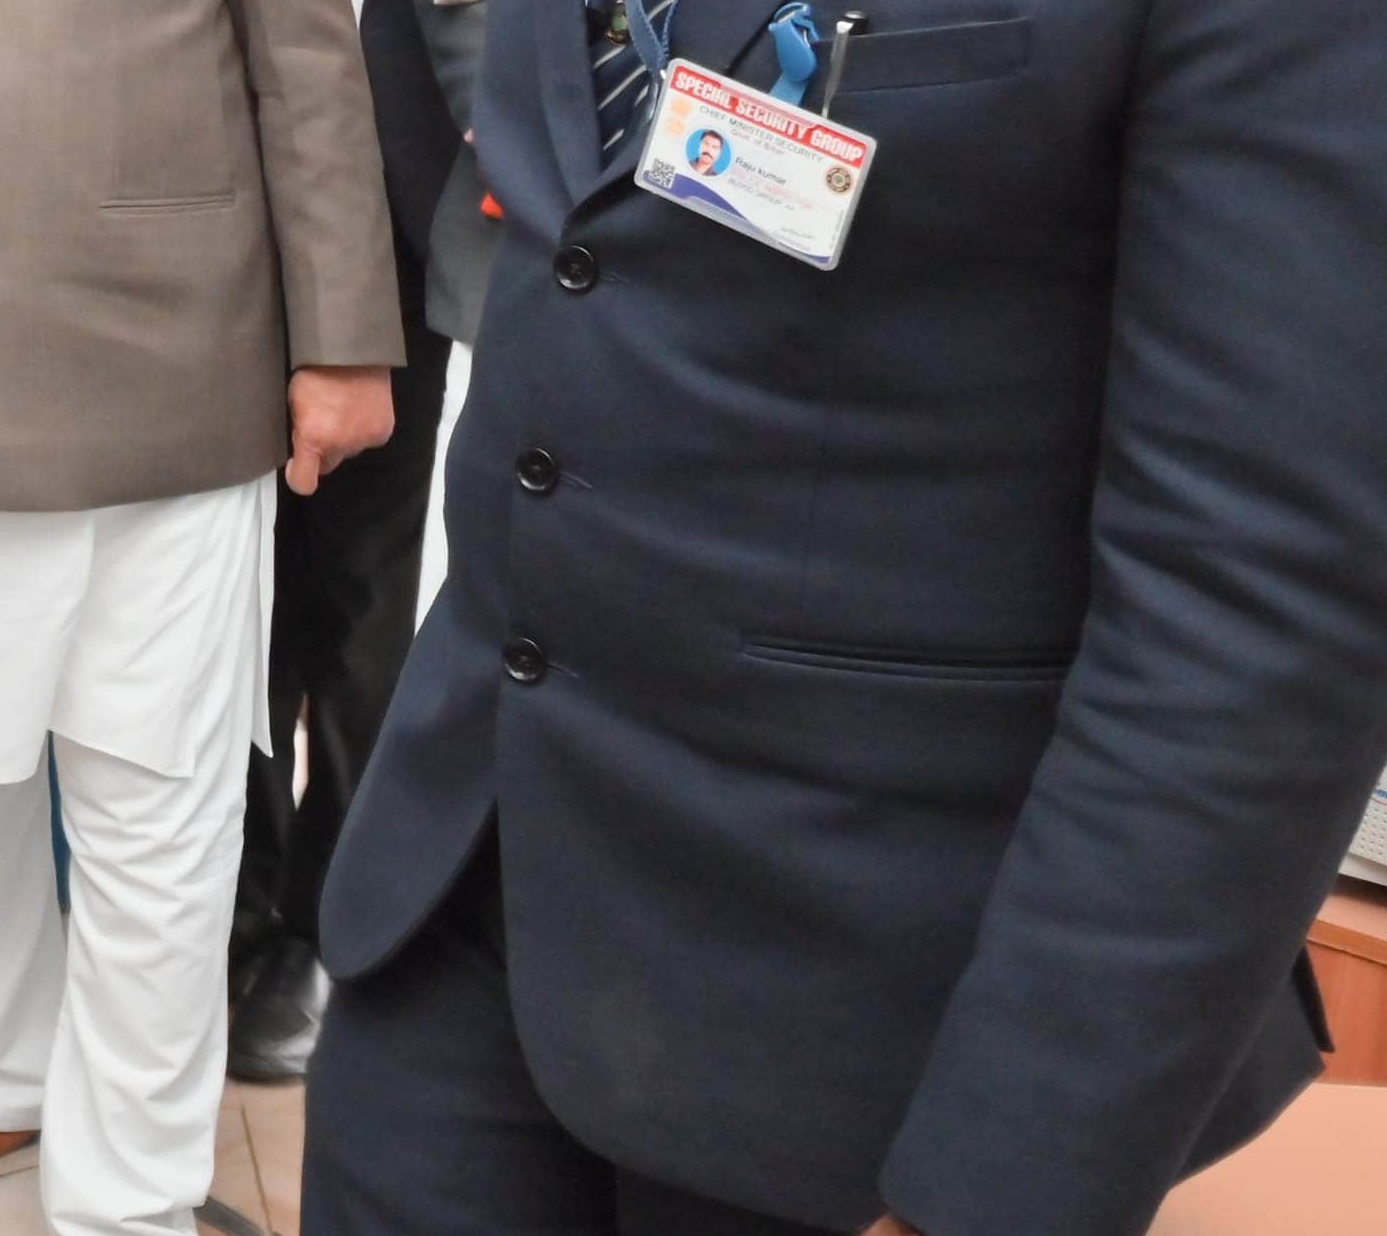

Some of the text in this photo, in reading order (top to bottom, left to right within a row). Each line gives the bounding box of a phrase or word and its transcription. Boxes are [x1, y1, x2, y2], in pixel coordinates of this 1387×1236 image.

[675, 72, 864, 164] SPECIAL SECURITY GROUP
[700, 105, 825, 164] CHIEF MINISTER SECURITY
